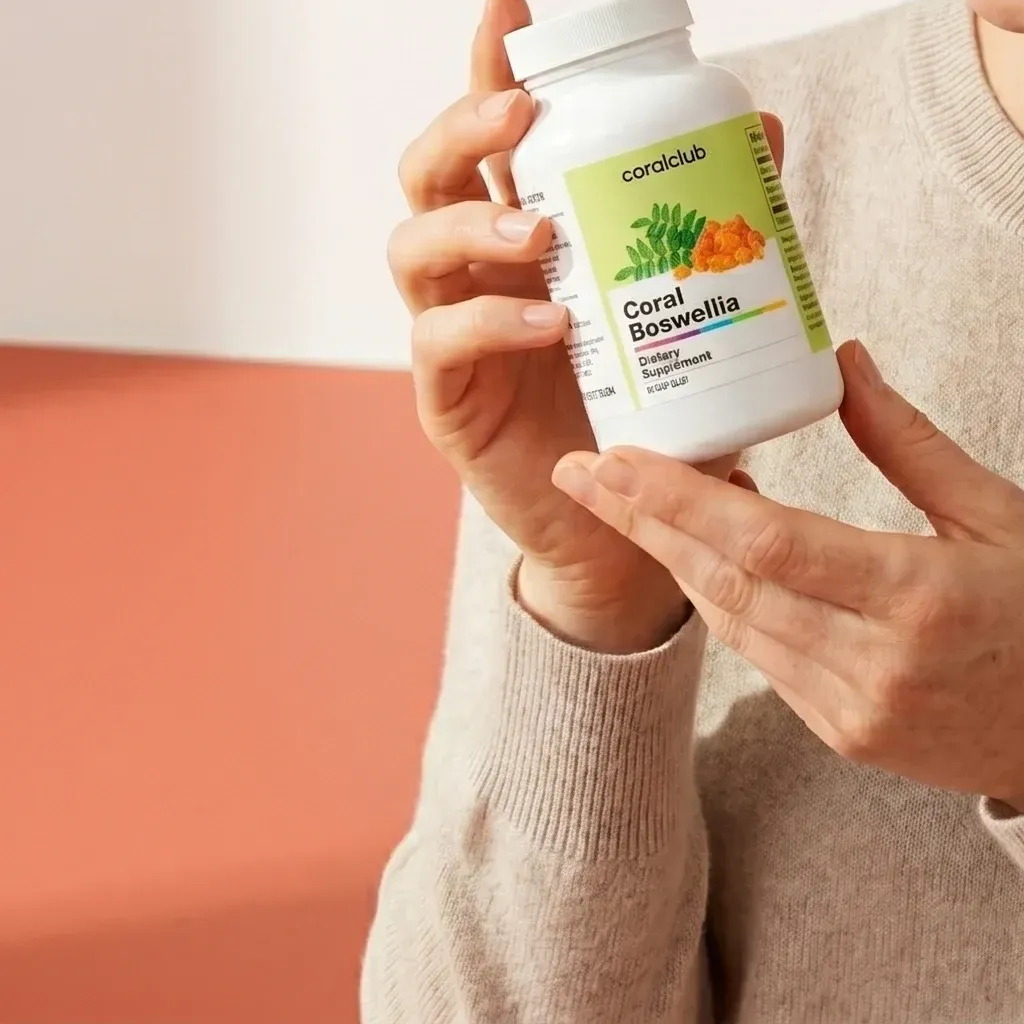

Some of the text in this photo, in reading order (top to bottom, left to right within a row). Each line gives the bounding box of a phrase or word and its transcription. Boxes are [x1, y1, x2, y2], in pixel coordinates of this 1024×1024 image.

[622, 144, 706, 182] coralclub
[623, 286, 684, 319] Coral
[628, 296, 740, 342] Boswellia
